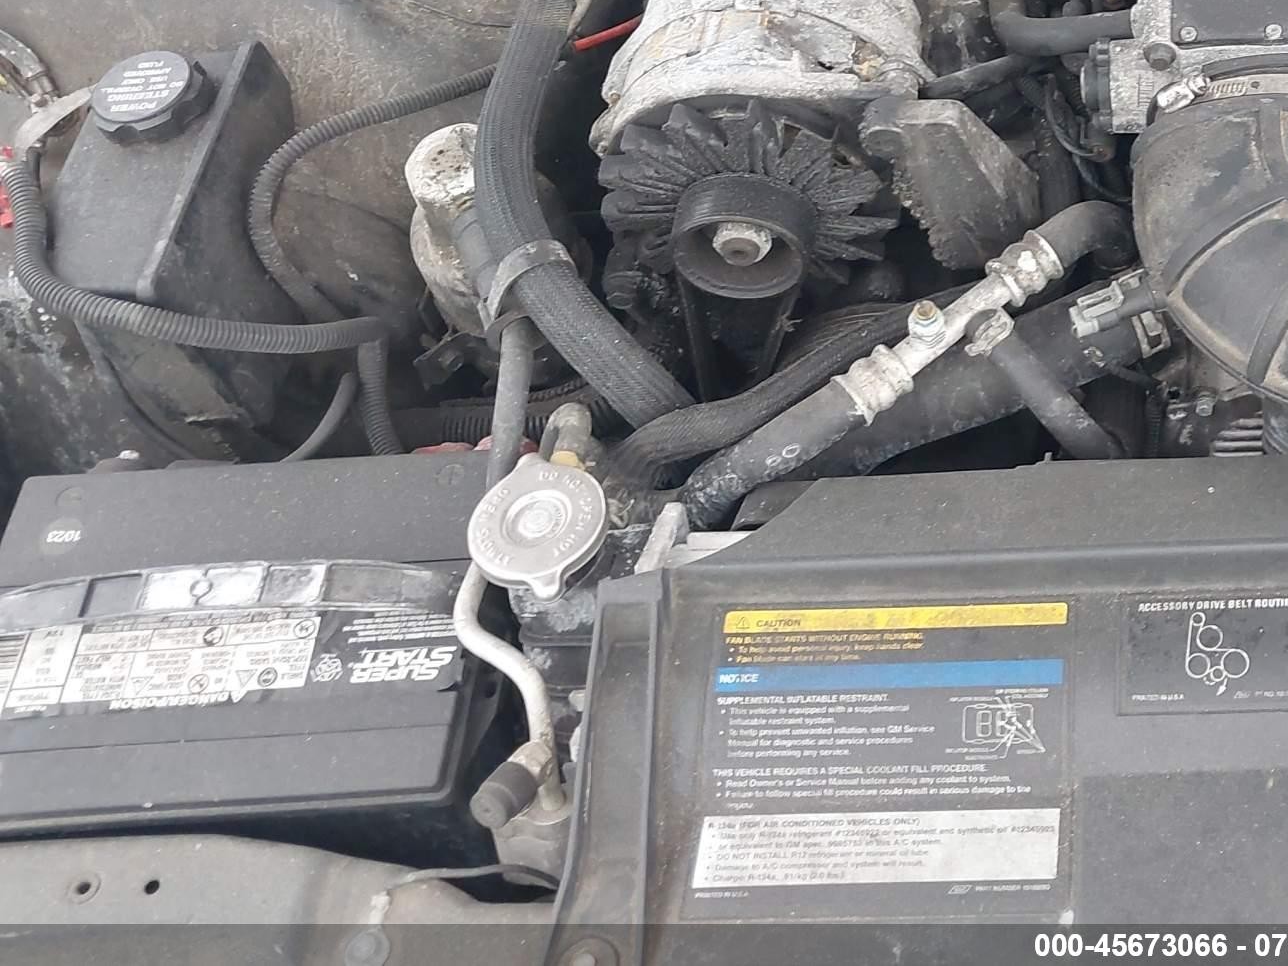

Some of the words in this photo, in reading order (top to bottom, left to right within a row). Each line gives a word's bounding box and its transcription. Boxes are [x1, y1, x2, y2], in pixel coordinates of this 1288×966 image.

[107, 90, 169, 101] STEERING
[110, 101, 158, 112] POWER
[46, 531, 81, 543] 1023
[1138, 600, 1195, 612] ACCESSORY
[1196, 600, 1226, 610] DRIVE
[1228, 599, 1253, 609] BELT
[756, 619, 801, 627] CAUTION
[353, 647, 457, 669] START
[350, 666, 439, 683] SUPER
[719, 673, 759, 684] NOTICE
[712, 768, 733, 776] THIS
[734, 767, 771, 776] VEHICLE
[772, 767, 819, 776] REQUIRES
[820, 767, 827, 775] A
[828, 766, 864, 775] SPECIAL
[866, 765, 910, 774] COOLANT
[911, 765, 930, 773] FILL
